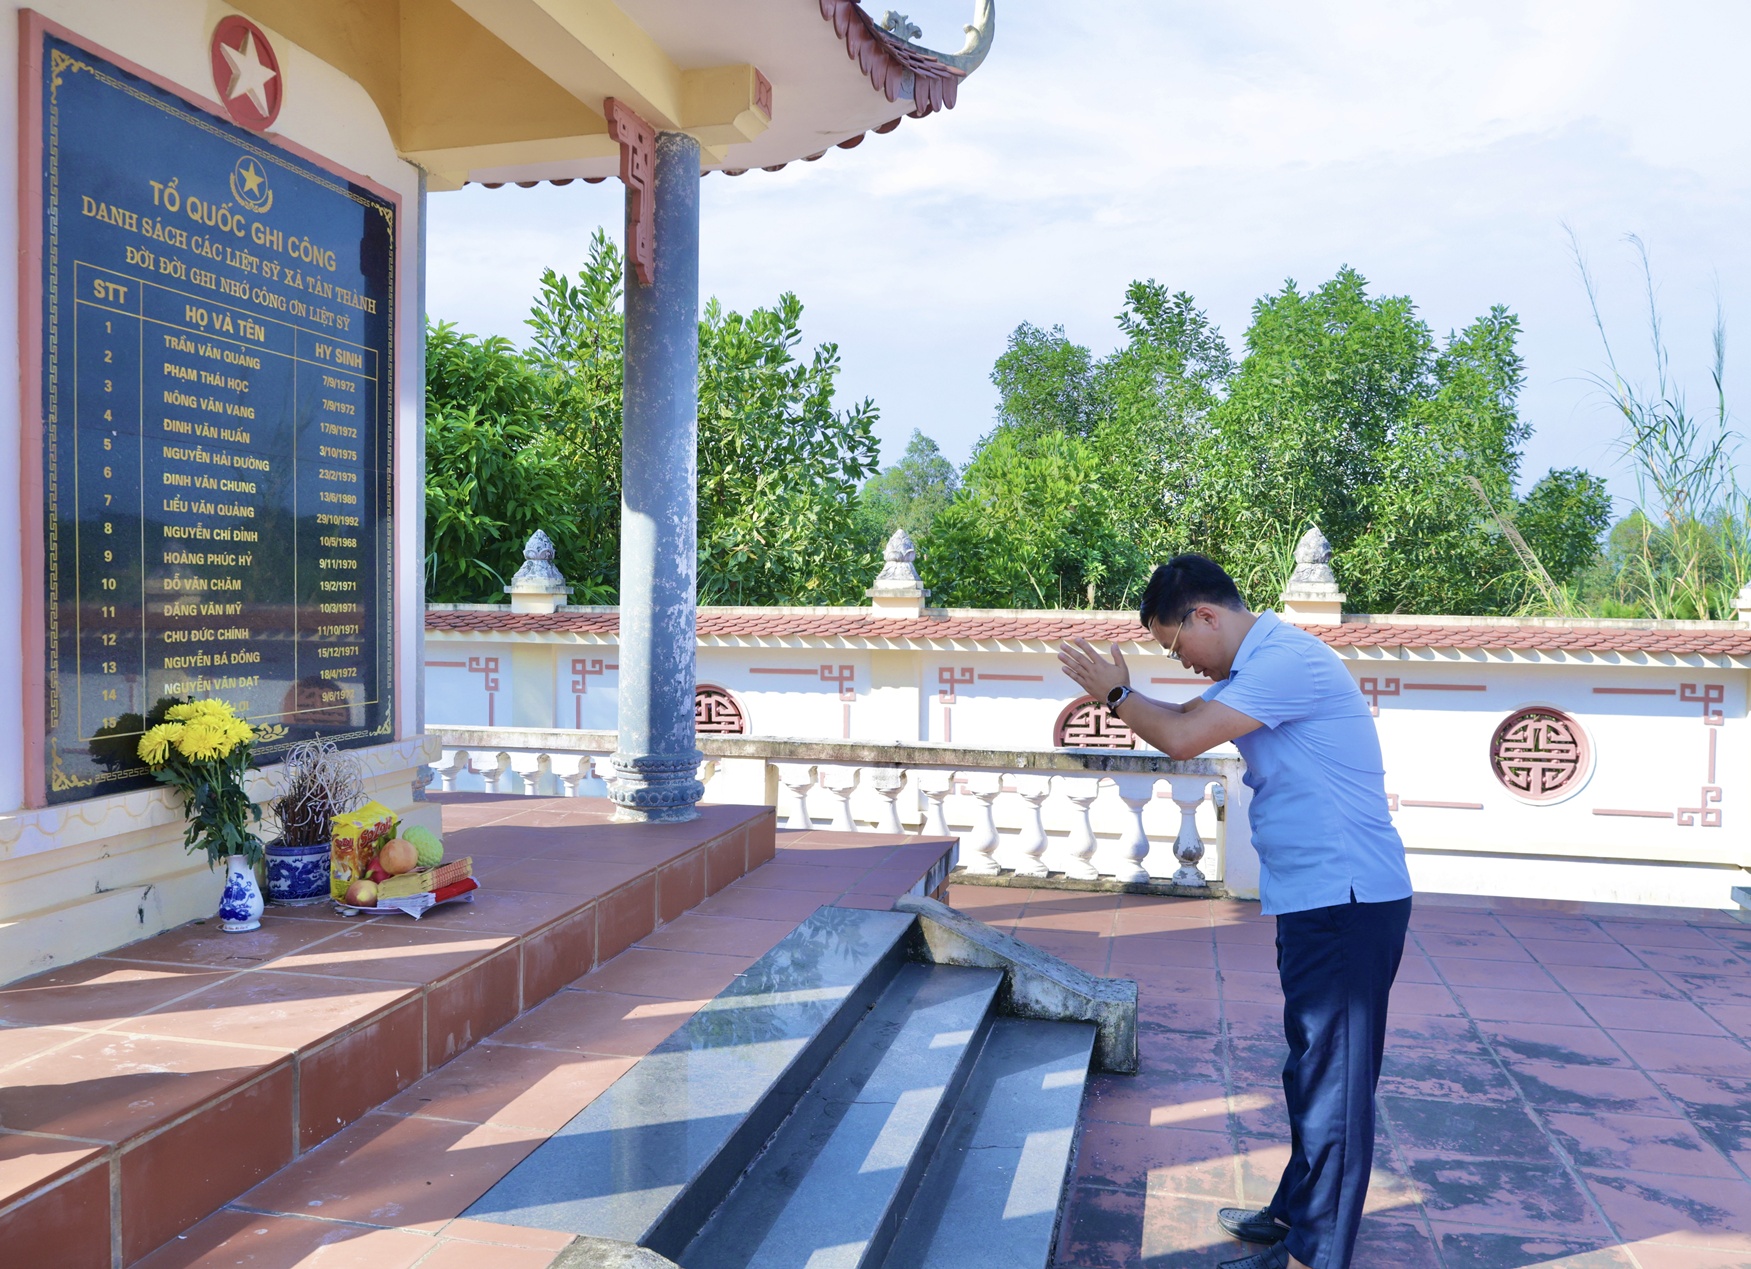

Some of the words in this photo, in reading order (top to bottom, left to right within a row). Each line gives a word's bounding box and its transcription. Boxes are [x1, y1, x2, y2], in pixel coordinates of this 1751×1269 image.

[149, 176, 180, 212] TỔ
[186, 196, 246, 236] QUỐC
[250, 222, 282, 251] GHI
[287, 236, 336, 271] CÔNG
[81, 195, 137, 232] DANH
[141, 217, 187, 249] SÁCH
[191, 234, 222, 260] CÁC
[225, 247, 259, 273] LIỆT
[262, 260, 280, 280] SỸ
[284, 268, 303, 288] XÃ
[306, 275, 332, 298] TÂN
[335, 286, 376, 314] THÀNH
[93, 278, 127, 303] STT
[125, 245, 154, 269] ĐỜI
[159, 256, 186, 279] ĐỜI
[190, 267, 216, 289] GHI
[219, 276, 249, 299] NHỚ
[252, 286, 286, 310] CÔNG
[289, 299, 306, 316] ƠN
[309, 306, 334, 326] LIỆT
[336, 314, 350, 330] SỸ
[105, 321, 111, 333] 1
[185, 304, 207, 330] HỌ
[213, 312, 233, 333] VÀ
[237, 318, 264, 341] TÊN
[104, 349, 112, 362] 2
[163, 334, 194, 353] TRẦN
[197, 343, 221, 359] VĂN
[224, 346, 260, 369] QUẢNG
[315, 342, 331, 359] HY
[335, 348, 361, 368] SINH
[163, 362, 197, 381] PHẠM
[199, 371, 226, 388] THÁI
[228, 376, 248, 394] HỌC
[322, 375, 354, 392] 7/9/1972
[104, 379, 112, 392] 3
[163, 389, 197, 408] NÔNG
[199, 396, 223, 412] VĂN
[225, 403, 254, 418] VANG
[322, 398, 354, 414] 7/9/1972
[103, 409, 112, 421] 4
[163, 418, 191, 434] ĐINH
[194, 422, 218, 438] VĂN
[220, 427, 250, 443] HUẤN
[320, 422, 356, 438] 17/9/1972
[103, 438, 111, 450] 5
[162, 445, 210, 463] NGUYỄN
[212, 450, 231, 466] HẢI
[232, 455, 269, 471] ĐƯỜNG
[319, 445, 356, 460] 3/10/1975
[103, 466, 112, 478] 6
[318, 468, 356, 482] 23/2/1979
[162, 472, 191, 486] ĐINH
[193, 474, 217, 489] VĂN
[219, 479, 256, 493] CHUNG
[103, 493, 111, 505] 7
[319, 491, 356, 504] 13/6/1980
[163, 494, 188, 512] LIỂU
[190, 499, 214, 514] VĂN
[217, 501, 254, 517] QUẢNG
[316, 513, 359, 526] 29/10/1992
[103, 522, 112, 534] 8
[163, 522, 210, 539] NGUYỄN
[213, 527, 230, 540] CHÍ
[233, 526, 258, 542] ĐỈNH
[319, 536, 357, 547] 10/5/1968
[103, 550, 112, 562] 9
[163, 550, 204, 564] HOÀNG
[207, 551, 235, 565] PHÚC
[238, 550, 252, 565] HỶ
[319, 558, 357, 569] 9/11/1970
[101, 578, 116, 589] 10
[163, 573, 183, 589] ĐỖ
[184, 576, 207, 590] VĂN
[210, 576, 241, 590] CHĂM
[319, 581, 356, 591] 19/2/1971
[101, 605, 115, 617] 11
[163, 602, 197, 618] ĐẶNG
[200, 601, 224, 615] VĂN
[225, 601, 242, 614] MỸ
[318, 603, 357, 613] 10/3/1971
[164, 630, 188, 642] CHU
[190, 627, 214, 641] ĐỨC
[216, 626, 249, 640] CHÍNH
[317, 624, 358, 636] 11/10/1971
[102, 633, 116, 645] 12
[164, 650, 211, 668] NGUYỄN
[213, 651, 231, 665] BÁ
[232, 648, 260, 663] ĐỒNG
[317, 645, 359, 657] 15/12/1971
[102, 661, 116, 673] 13
[319, 667, 357, 679] 18/4/1972
[164, 676, 210, 694] NGUYỄN
[213, 676, 236, 689] VĂN
[238, 675, 259, 688] ĐẠT
[102, 688, 116, 700] 14
[102, 716, 116, 727] 15
